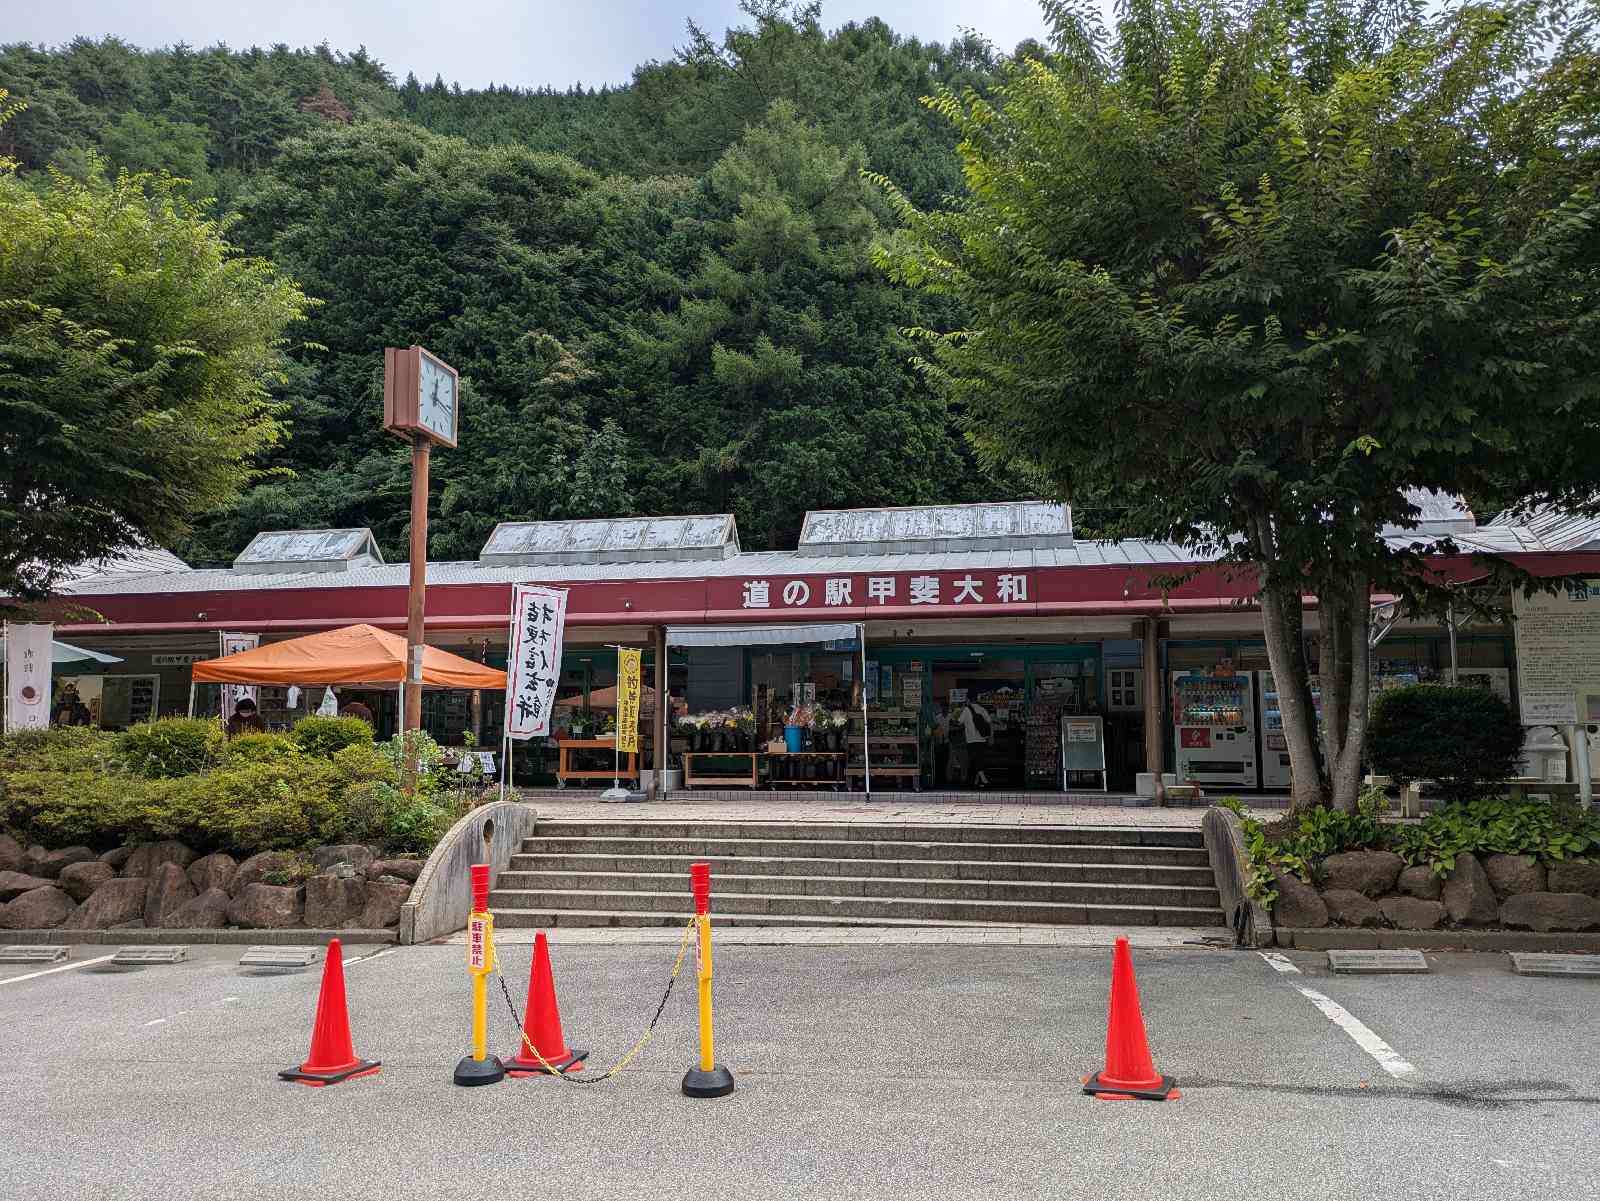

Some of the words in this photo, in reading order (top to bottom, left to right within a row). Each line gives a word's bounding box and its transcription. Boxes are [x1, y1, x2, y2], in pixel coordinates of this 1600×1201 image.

[742, 573, 1028, 608] 道の駅甲斐大和
[471, 920, 483, 967] 駐車禁止
